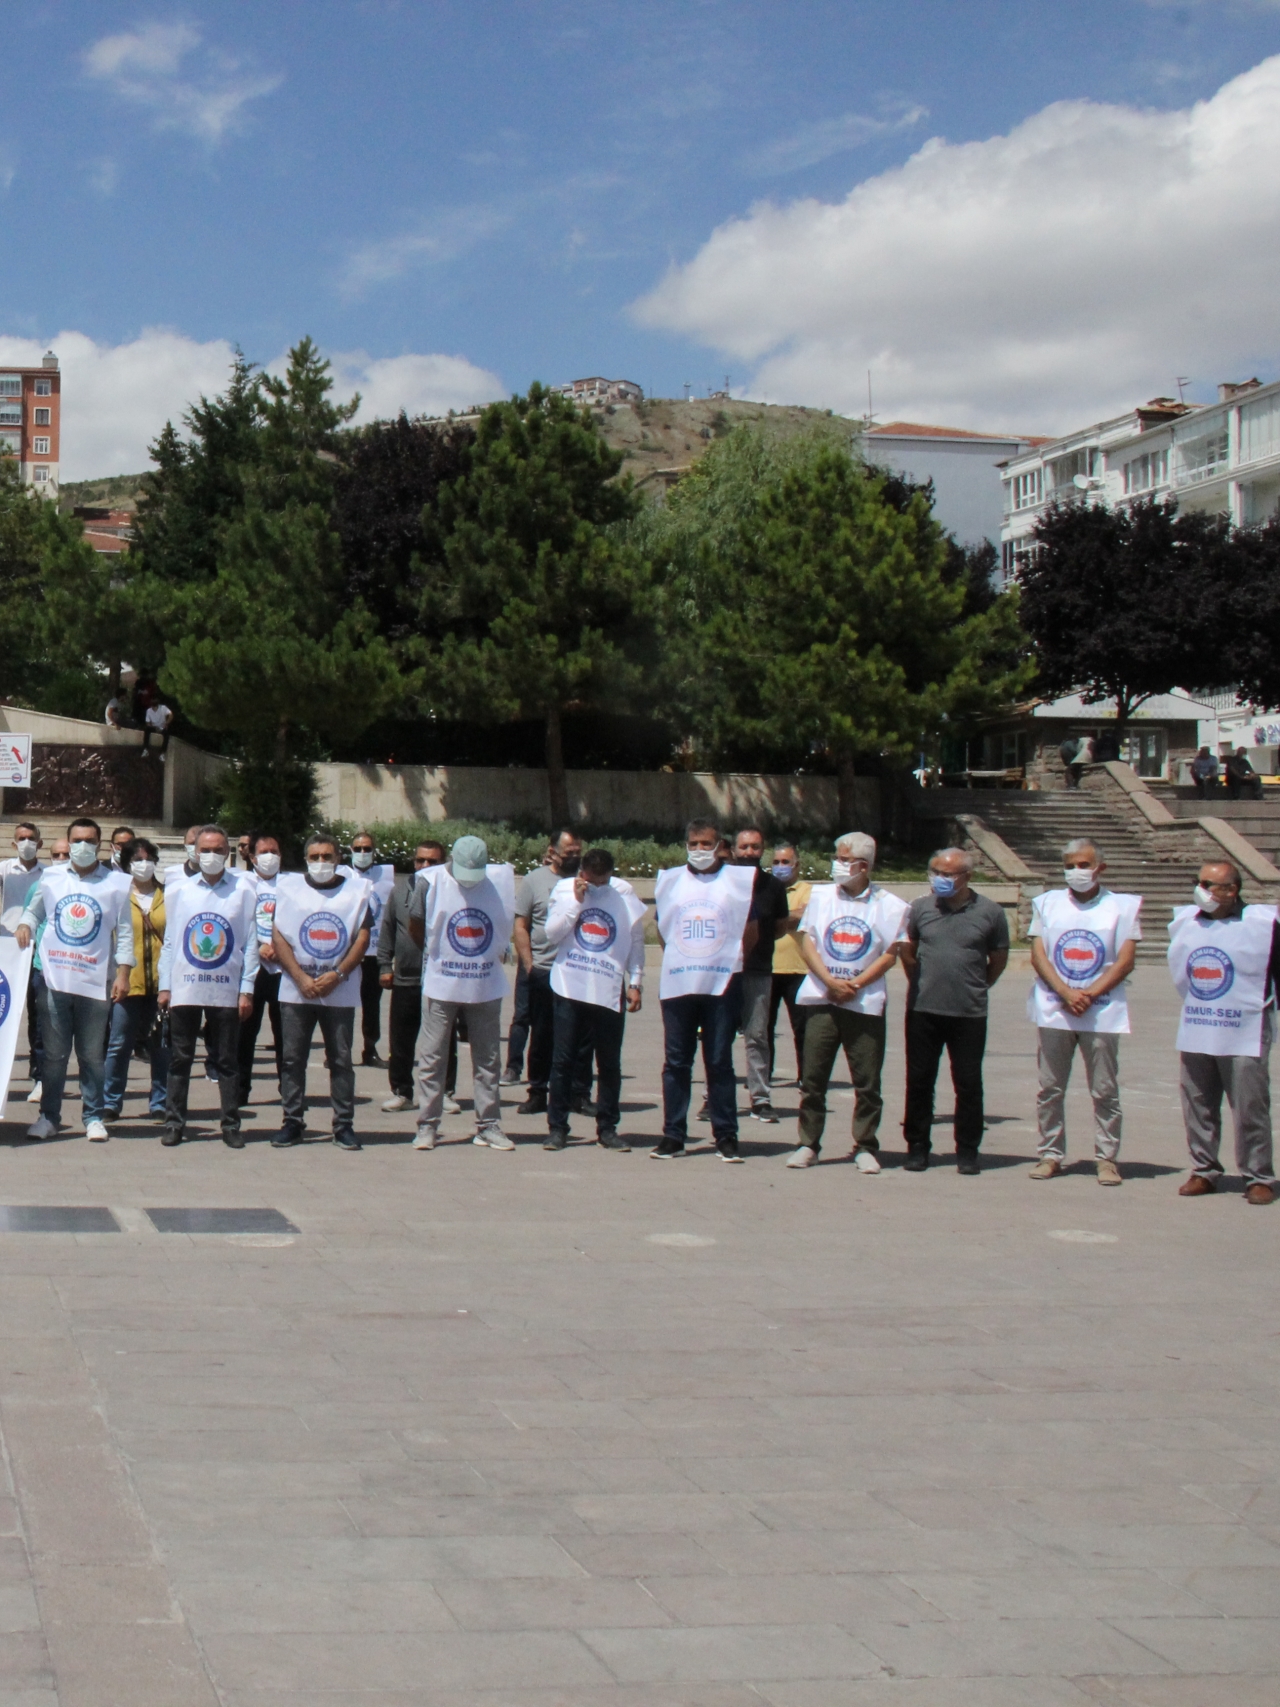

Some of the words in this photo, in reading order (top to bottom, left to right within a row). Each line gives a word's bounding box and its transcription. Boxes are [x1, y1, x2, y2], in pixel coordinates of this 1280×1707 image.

[188, 916, 200, 928] TOÇ
[202, 914, 229, 930] BİR-SEN
[304, 913, 342, 928] MEMUR-SEN
[1058, 931, 1102, 947] MEMUR-SEN
[567, 952, 615, 971] MEMUR-SEN
[1188, 948, 1230, 965] MEMUR-SEN
[183, 974, 196, 984] TOÇ
[198, 974, 230, 983] BİR-SEN
